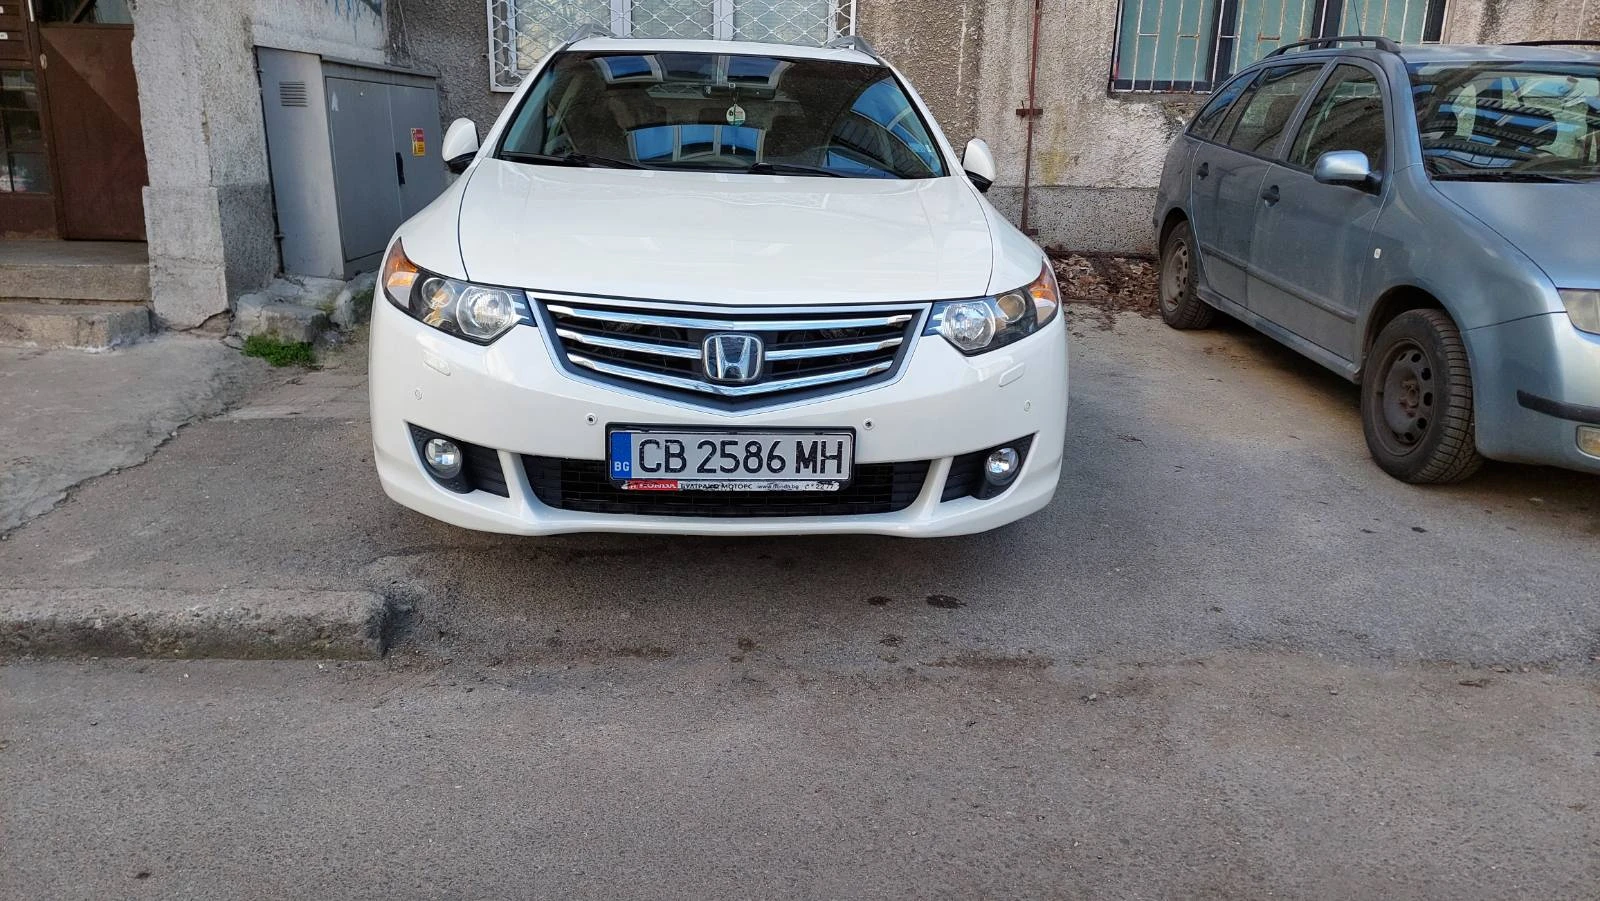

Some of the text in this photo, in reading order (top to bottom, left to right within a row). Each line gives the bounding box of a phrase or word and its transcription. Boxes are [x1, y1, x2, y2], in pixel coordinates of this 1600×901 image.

[614, 461, 630, 472] BG
[638, 439, 844, 474] CB 2586 MH
